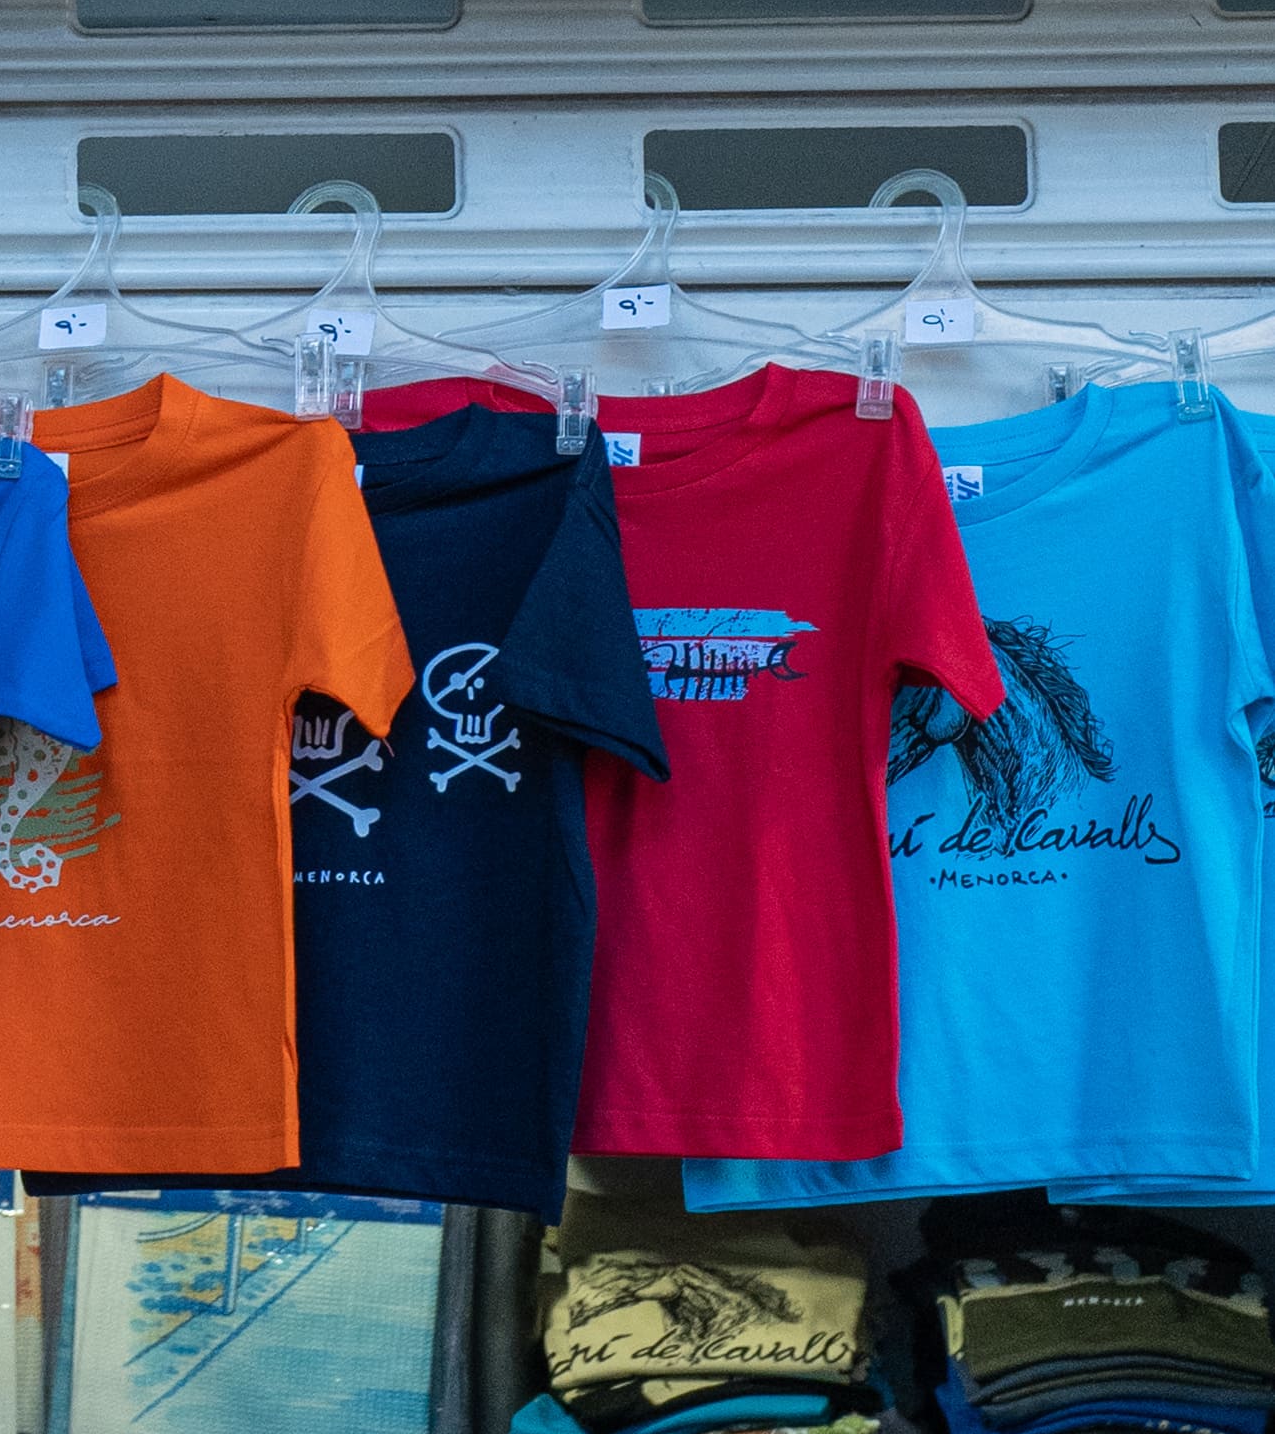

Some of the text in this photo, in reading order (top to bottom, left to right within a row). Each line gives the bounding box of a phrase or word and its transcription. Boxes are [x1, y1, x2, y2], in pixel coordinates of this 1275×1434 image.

[939, 794, 995, 854] de
[1009, 793, 1182, 866] Cavalls
[293, 870, 386, 886] MENORCA
[630, 1329, 681, 1361] de
